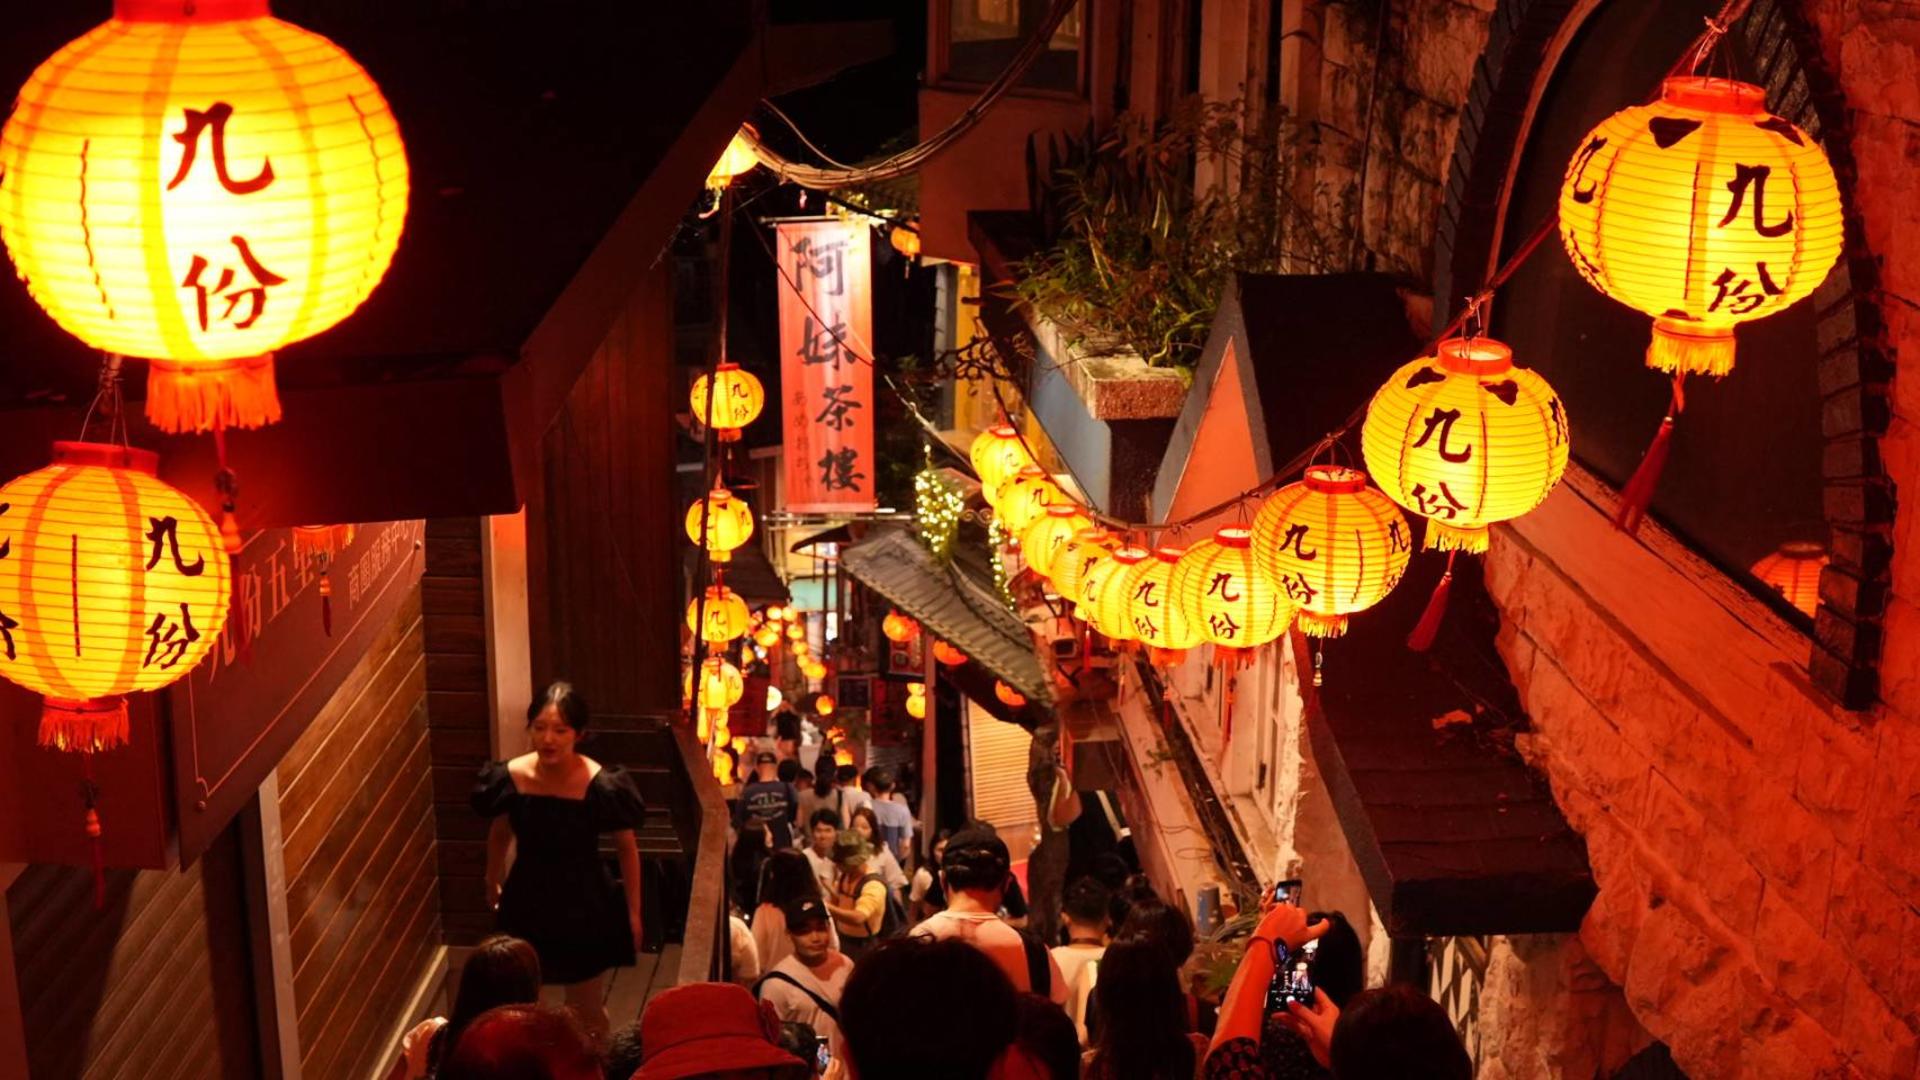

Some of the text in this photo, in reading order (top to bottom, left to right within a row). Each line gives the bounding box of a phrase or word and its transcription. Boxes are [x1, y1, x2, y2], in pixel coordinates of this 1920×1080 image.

[166, 101, 288, 332] 九份
[1708, 162, 1793, 314] 九份
[732, 383, 750, 421] 九份
[791, 236, 865, 492] 阿妹茶樓
[1411, 407, 1472, 520] 九份
[144, 515, 205, 670] 九份
[1133, 581, 1159, 640] 九份
[1207, 572, 1241, 640] 九份
[1279, 523, 1319, 605] 九份
